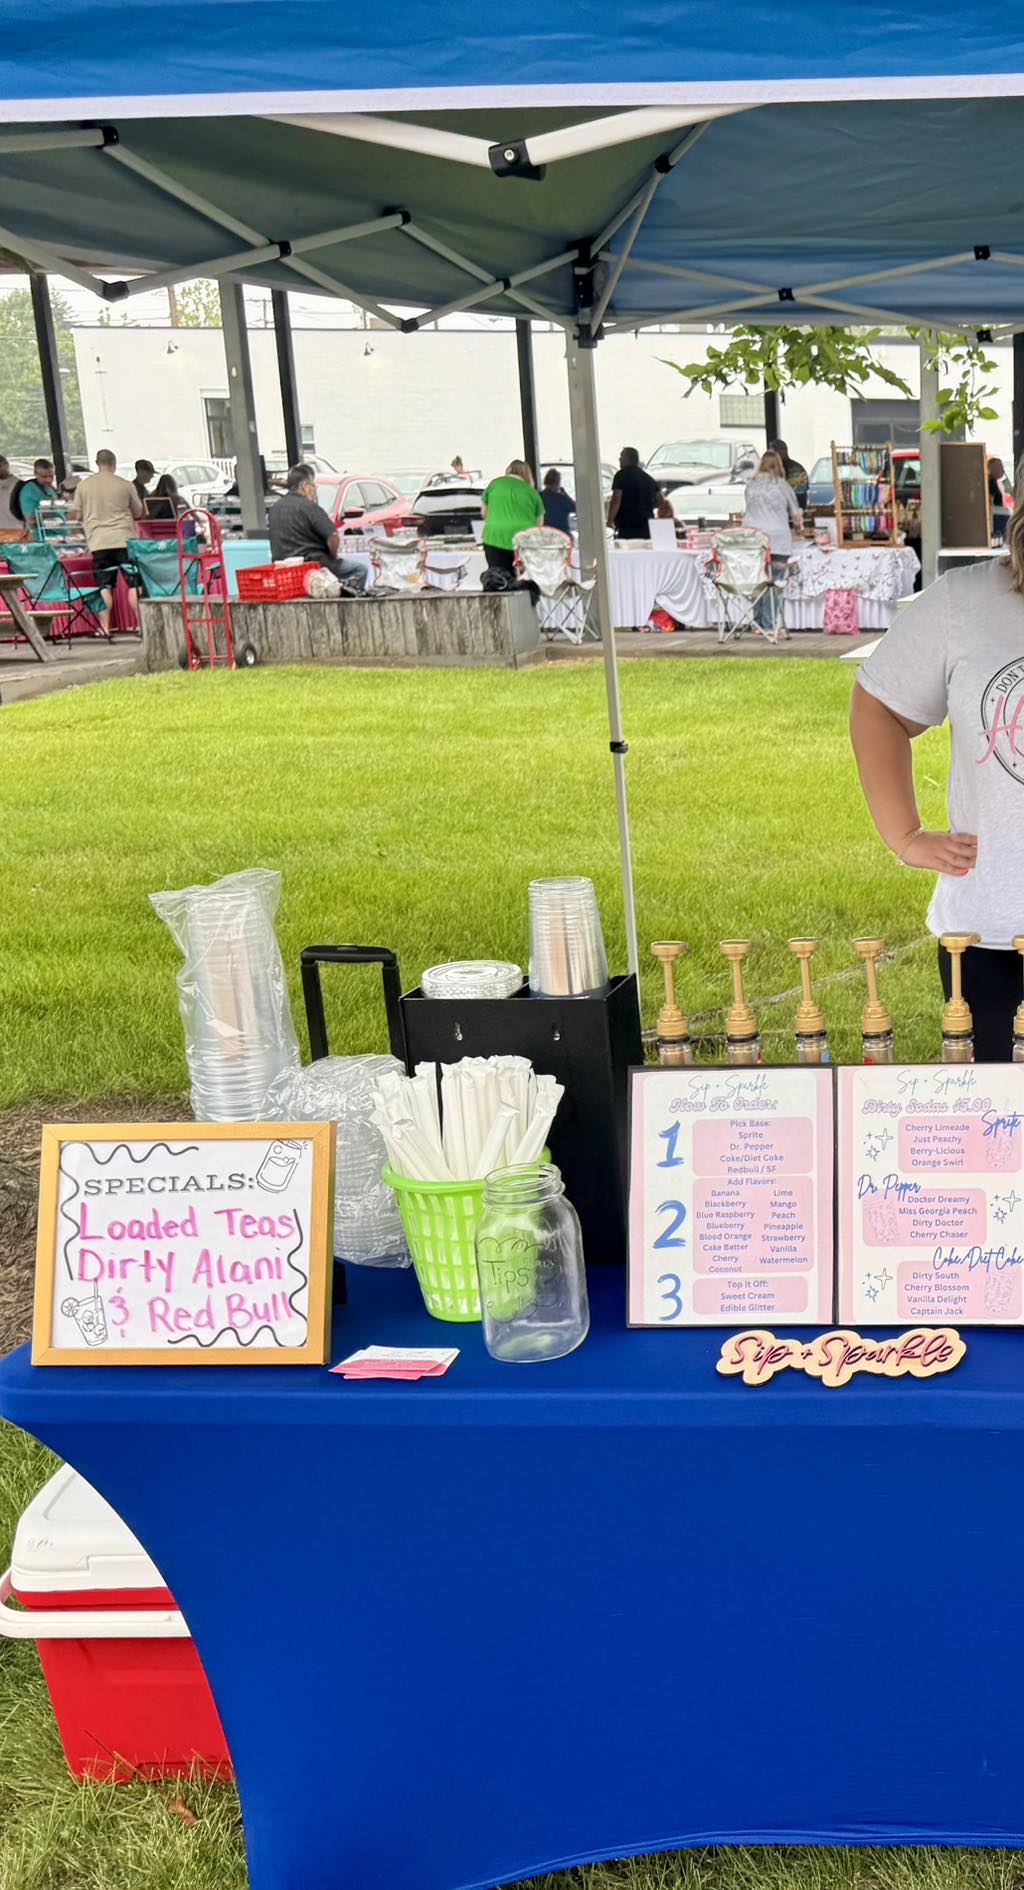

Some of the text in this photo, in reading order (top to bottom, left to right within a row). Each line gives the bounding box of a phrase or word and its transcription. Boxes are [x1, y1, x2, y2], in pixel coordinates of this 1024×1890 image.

[688, 1075, 710, 1100] Sip
[906, 1099, 949, 1114] Sodas
[952, 1098, 992, 1113] $5.00
[905, 1124, 933, 1133] Cherry
[738, 1132, 764, 1140] Sprite
[933, 1135, 961, 1144] Peachy
[656, 1120, 685, 1168] 1
[745, 1143, 773, 1152] Pepper
[720, 1154, 761, 1162] Coke/Diet
[912, 1159, 941, 1167] Orange
[84, 1173, 255, 1197] SPECIALS:
[705, 1200, 746, 1209] Blackberry
[770, 1201, 796, 1209] Mango
[938, 1196, 970, 1205] Dreamy
[715, 1211, 755, 1220] Raspberry
[772, 1211, 795, 1219] Peach
[919, 1207, 950, 1217] Georgia
[952, 1207, 977, 1215] Peach
[79, 1202, 294, 1241] Loaded Teas
[652, 1200, 687, 1249] 2
[707, 1222, 745, 1231] Blueberry
[764, 1222, 803, 1231] Pineapple
[723, 1233, 752, 1241] Orange
[762, 1234, 805, 1243] Strawberry
[726, 1243, 748, 1251] Batter
[712, 1255, 738, 1264] Cherry
[759, 1256, 808, 1264] Watermelon
[78, 1247, 282, 1293] Dirty Alani
[482, 1260, 529, 1293] Tips
[728, 1281, 743, 1289] Top
[753, 1280, 768, 1288] Off:
[657, 1273, 683, 1321] 3
[721, 1292, 746, 1300] Sweet
[937, 1295, 967, 1305] Delight
[148, 1295, 214, 1332] Red
[226, 1291, 292, 1328] Bull
[911, 1307, 942, 1316] Captain
[730, 1335, 793, 1376] Sip
[818, 1334, 954, 1377] Sparkle
